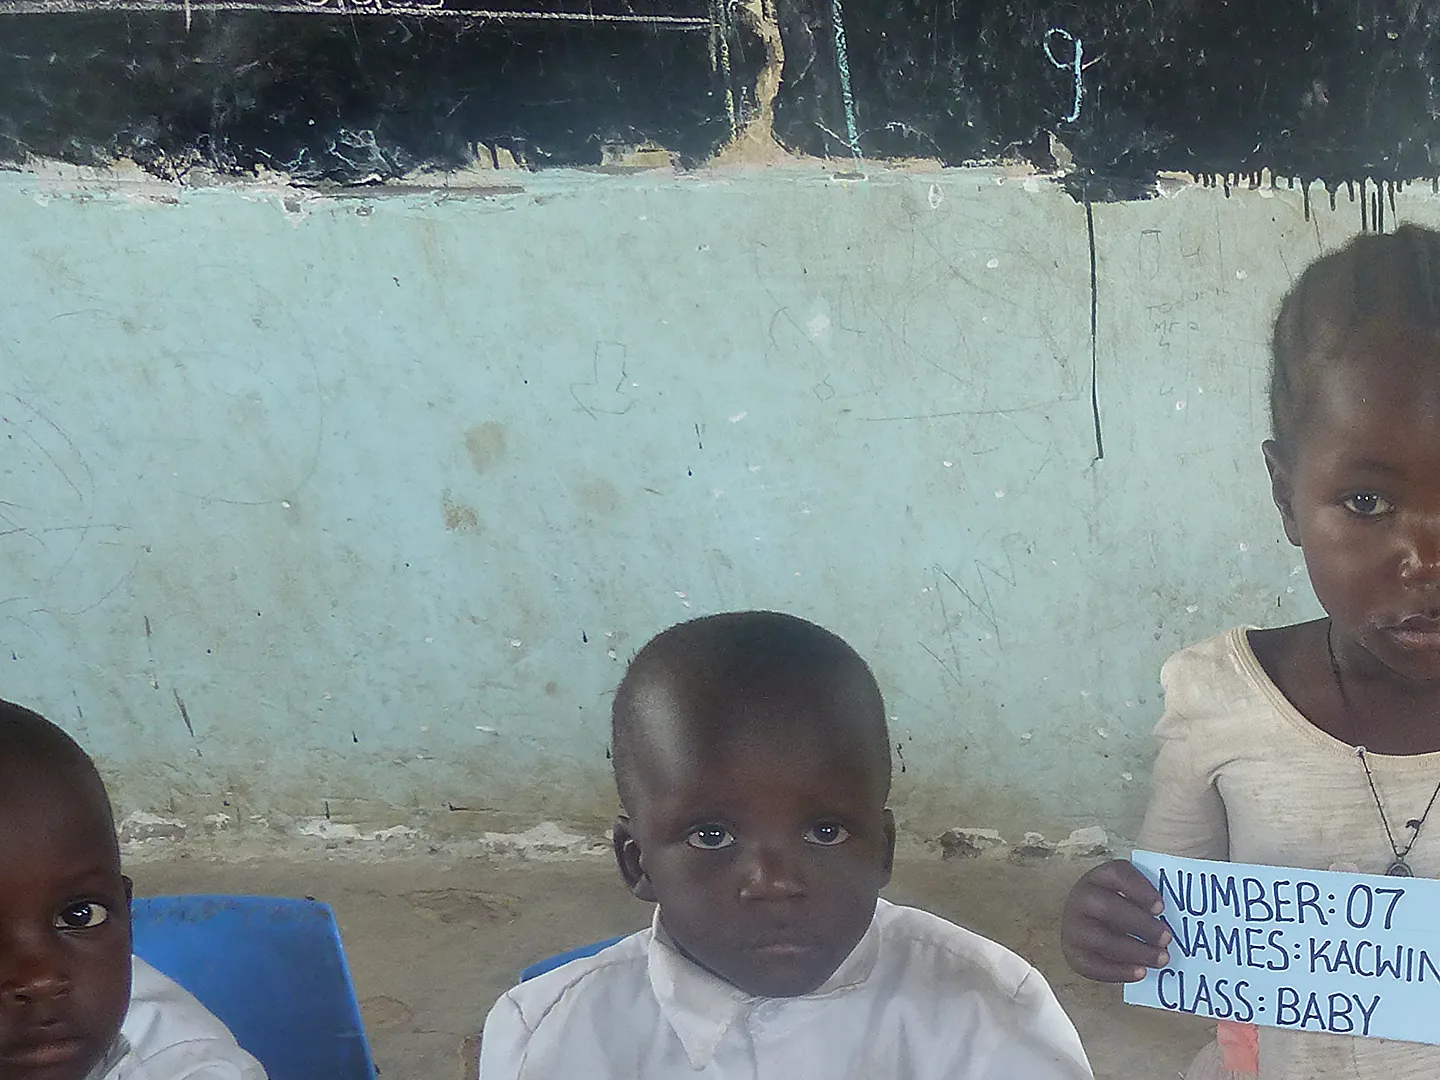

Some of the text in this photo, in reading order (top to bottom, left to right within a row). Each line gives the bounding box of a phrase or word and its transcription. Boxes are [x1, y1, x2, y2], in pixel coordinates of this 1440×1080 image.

[1158, 867, 1405, 930] NUMBER: 07
[1160, 915, 1302, 973] NAMES:
[1156, 968, 1381, 1036] CLASS: BABY
